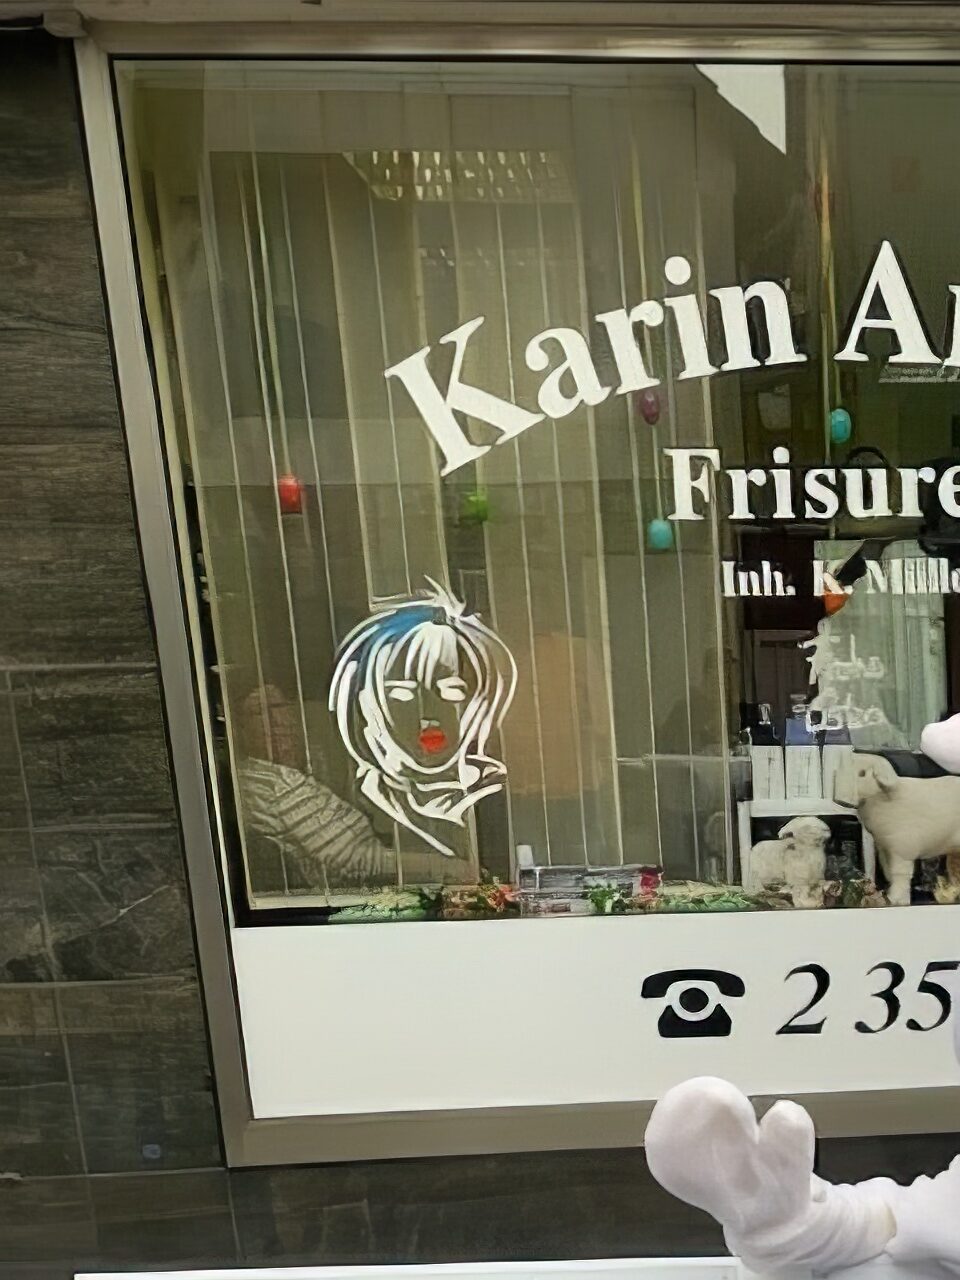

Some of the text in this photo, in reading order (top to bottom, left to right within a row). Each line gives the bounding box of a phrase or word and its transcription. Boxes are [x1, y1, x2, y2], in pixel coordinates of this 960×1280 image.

[385, 256, 806, 477] Karin
[722, 560, 796, 597] Inh.
[813, 559, 853, 596] K.
[775, 963, 831, 1035] 2
